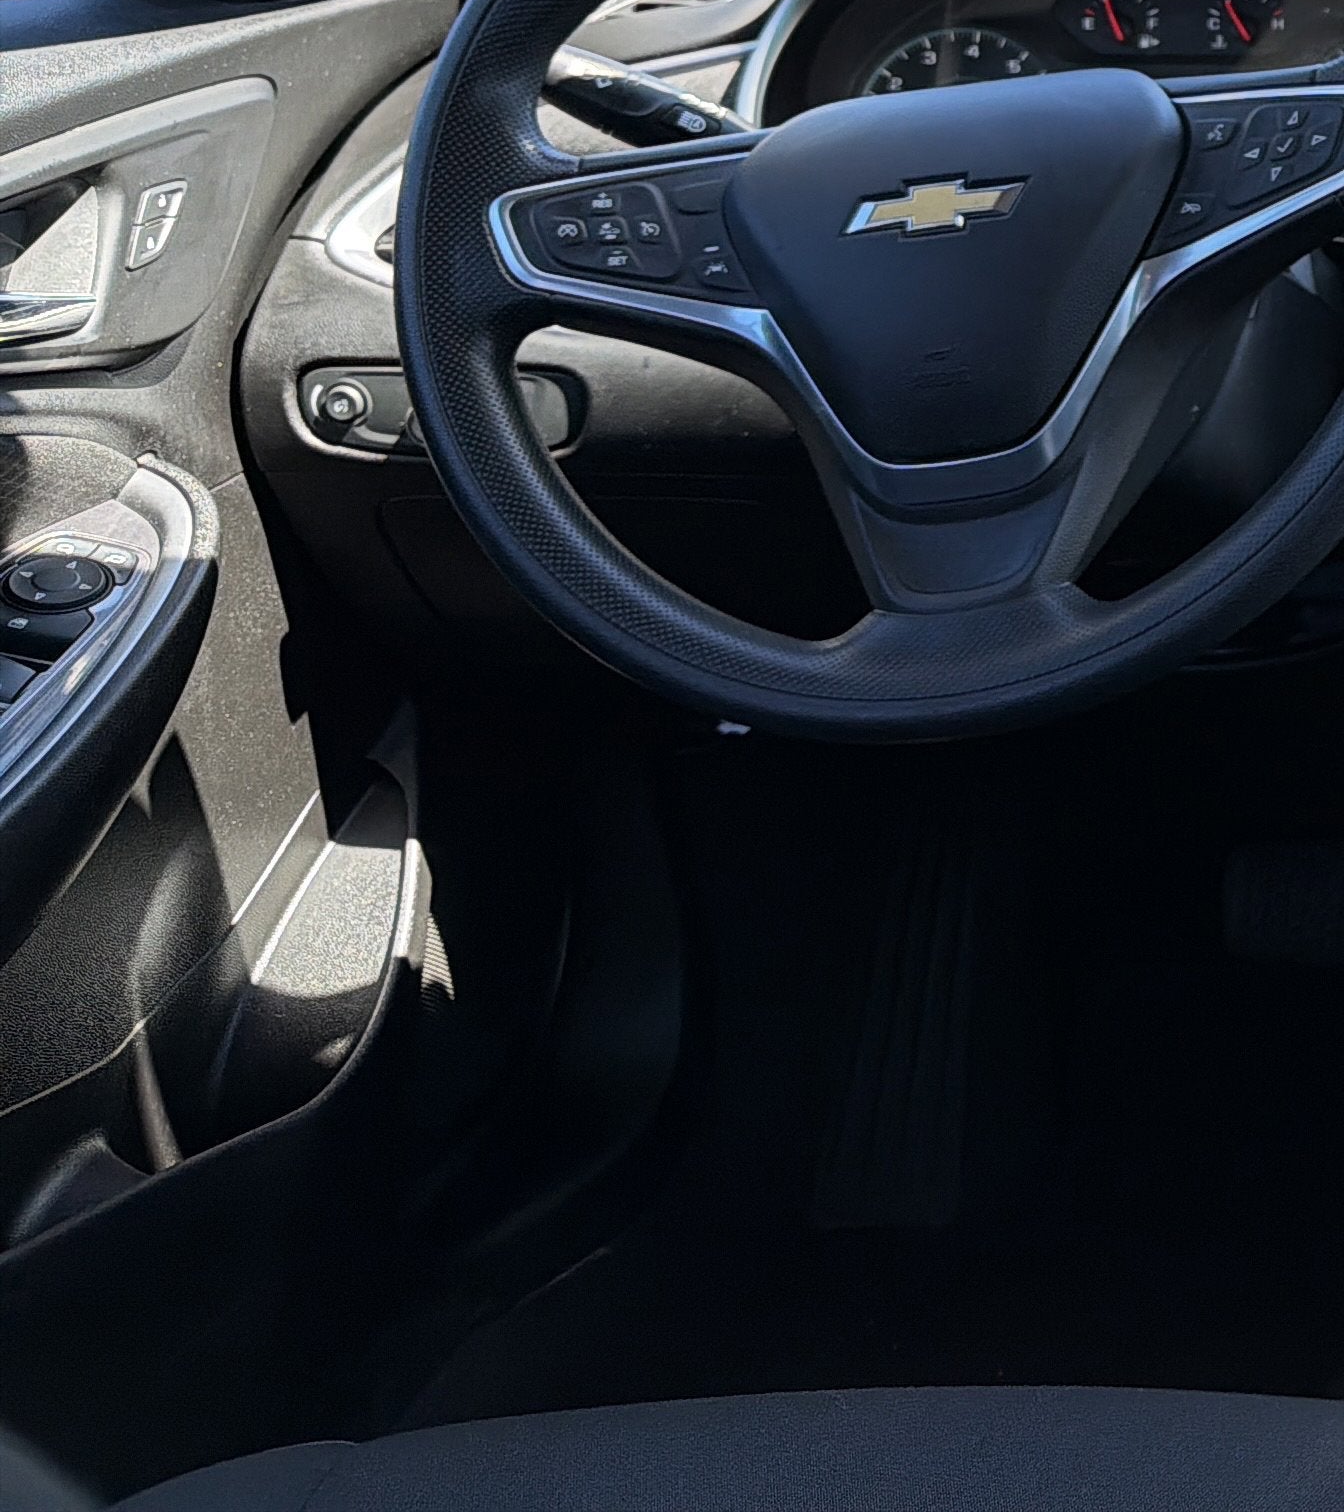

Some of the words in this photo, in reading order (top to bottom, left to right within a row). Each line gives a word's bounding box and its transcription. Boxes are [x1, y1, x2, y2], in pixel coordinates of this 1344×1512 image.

[1206, 17, 1220, 31] C
[1271, 17, 1285, 31] H
[964, 43, 980, 58] 4
[923, 51, 937, 66] 3
[889, 76, 903, 90] 2
